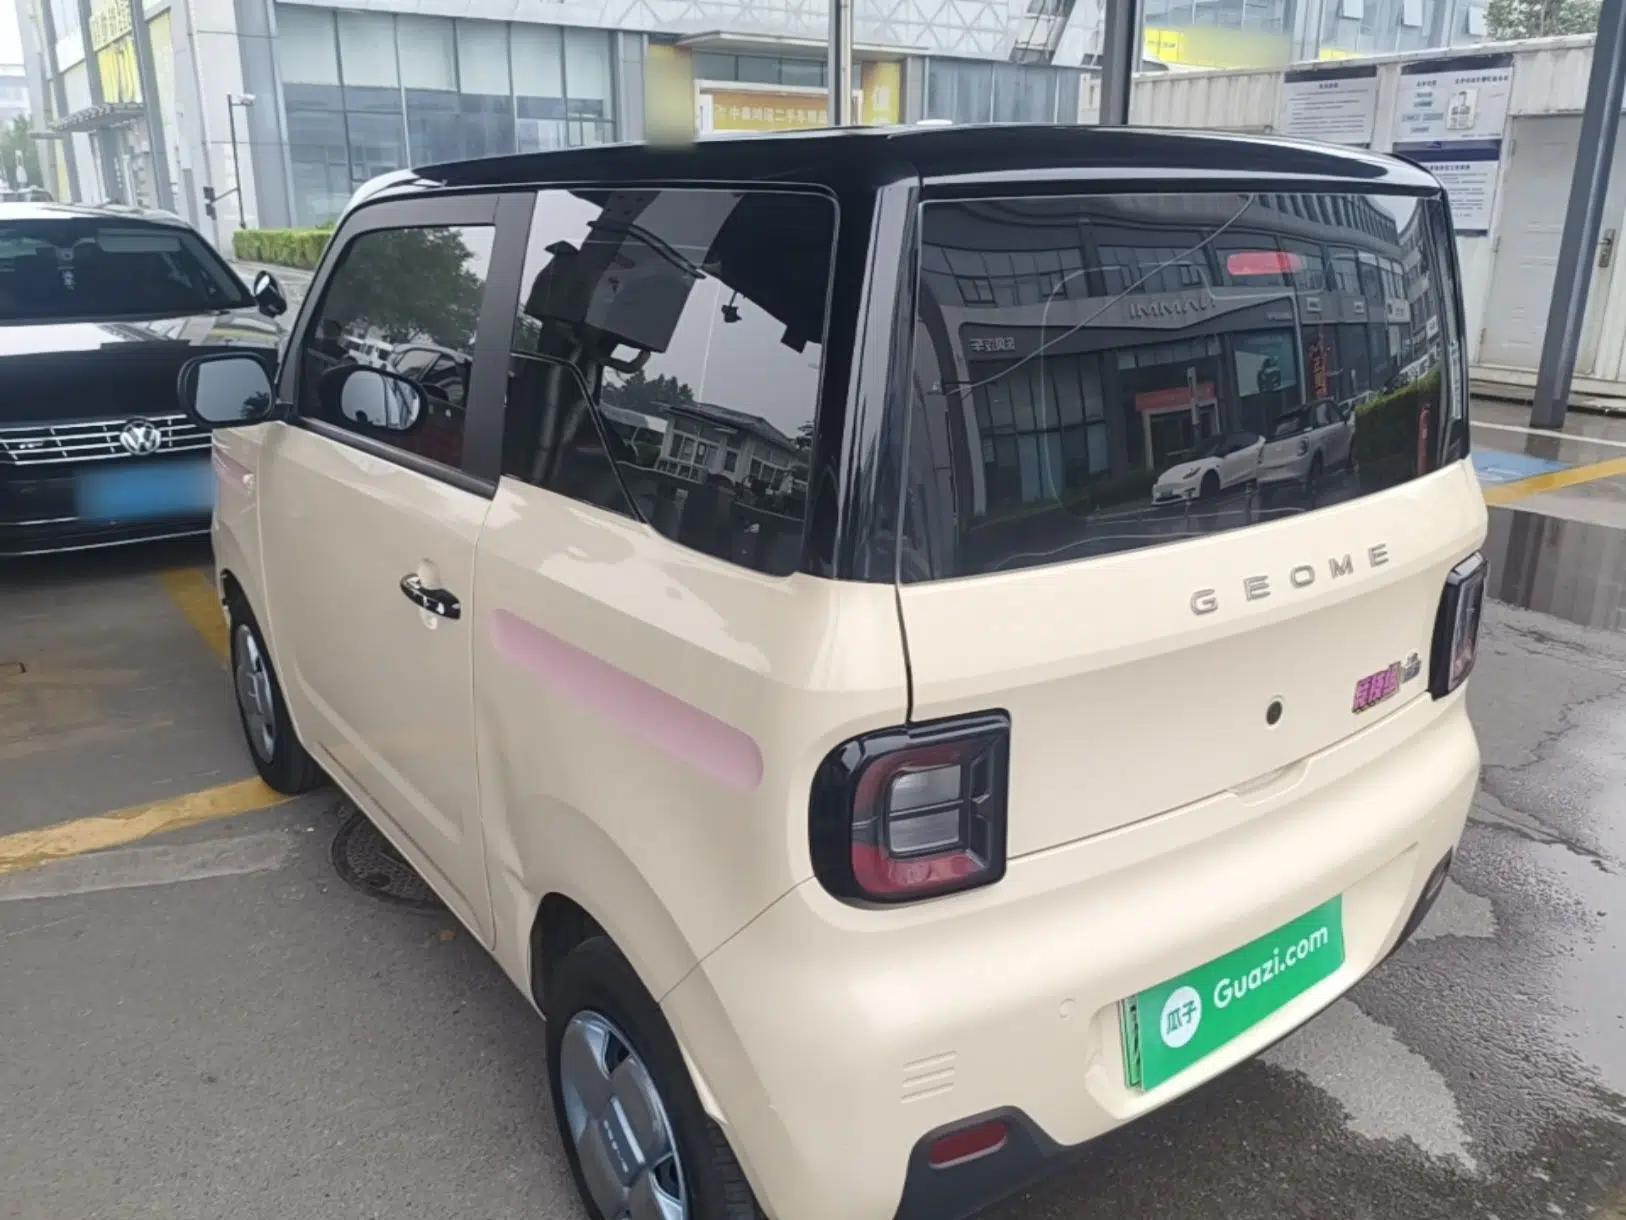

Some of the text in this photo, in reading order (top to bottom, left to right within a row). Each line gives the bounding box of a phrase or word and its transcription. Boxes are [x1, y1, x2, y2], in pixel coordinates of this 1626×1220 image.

[1189, 543, 1390, 615] GEOME
[1212, 925, 1329, 1009] Guazi.com
[1165, 998, 1198, 1036] 瓜子
